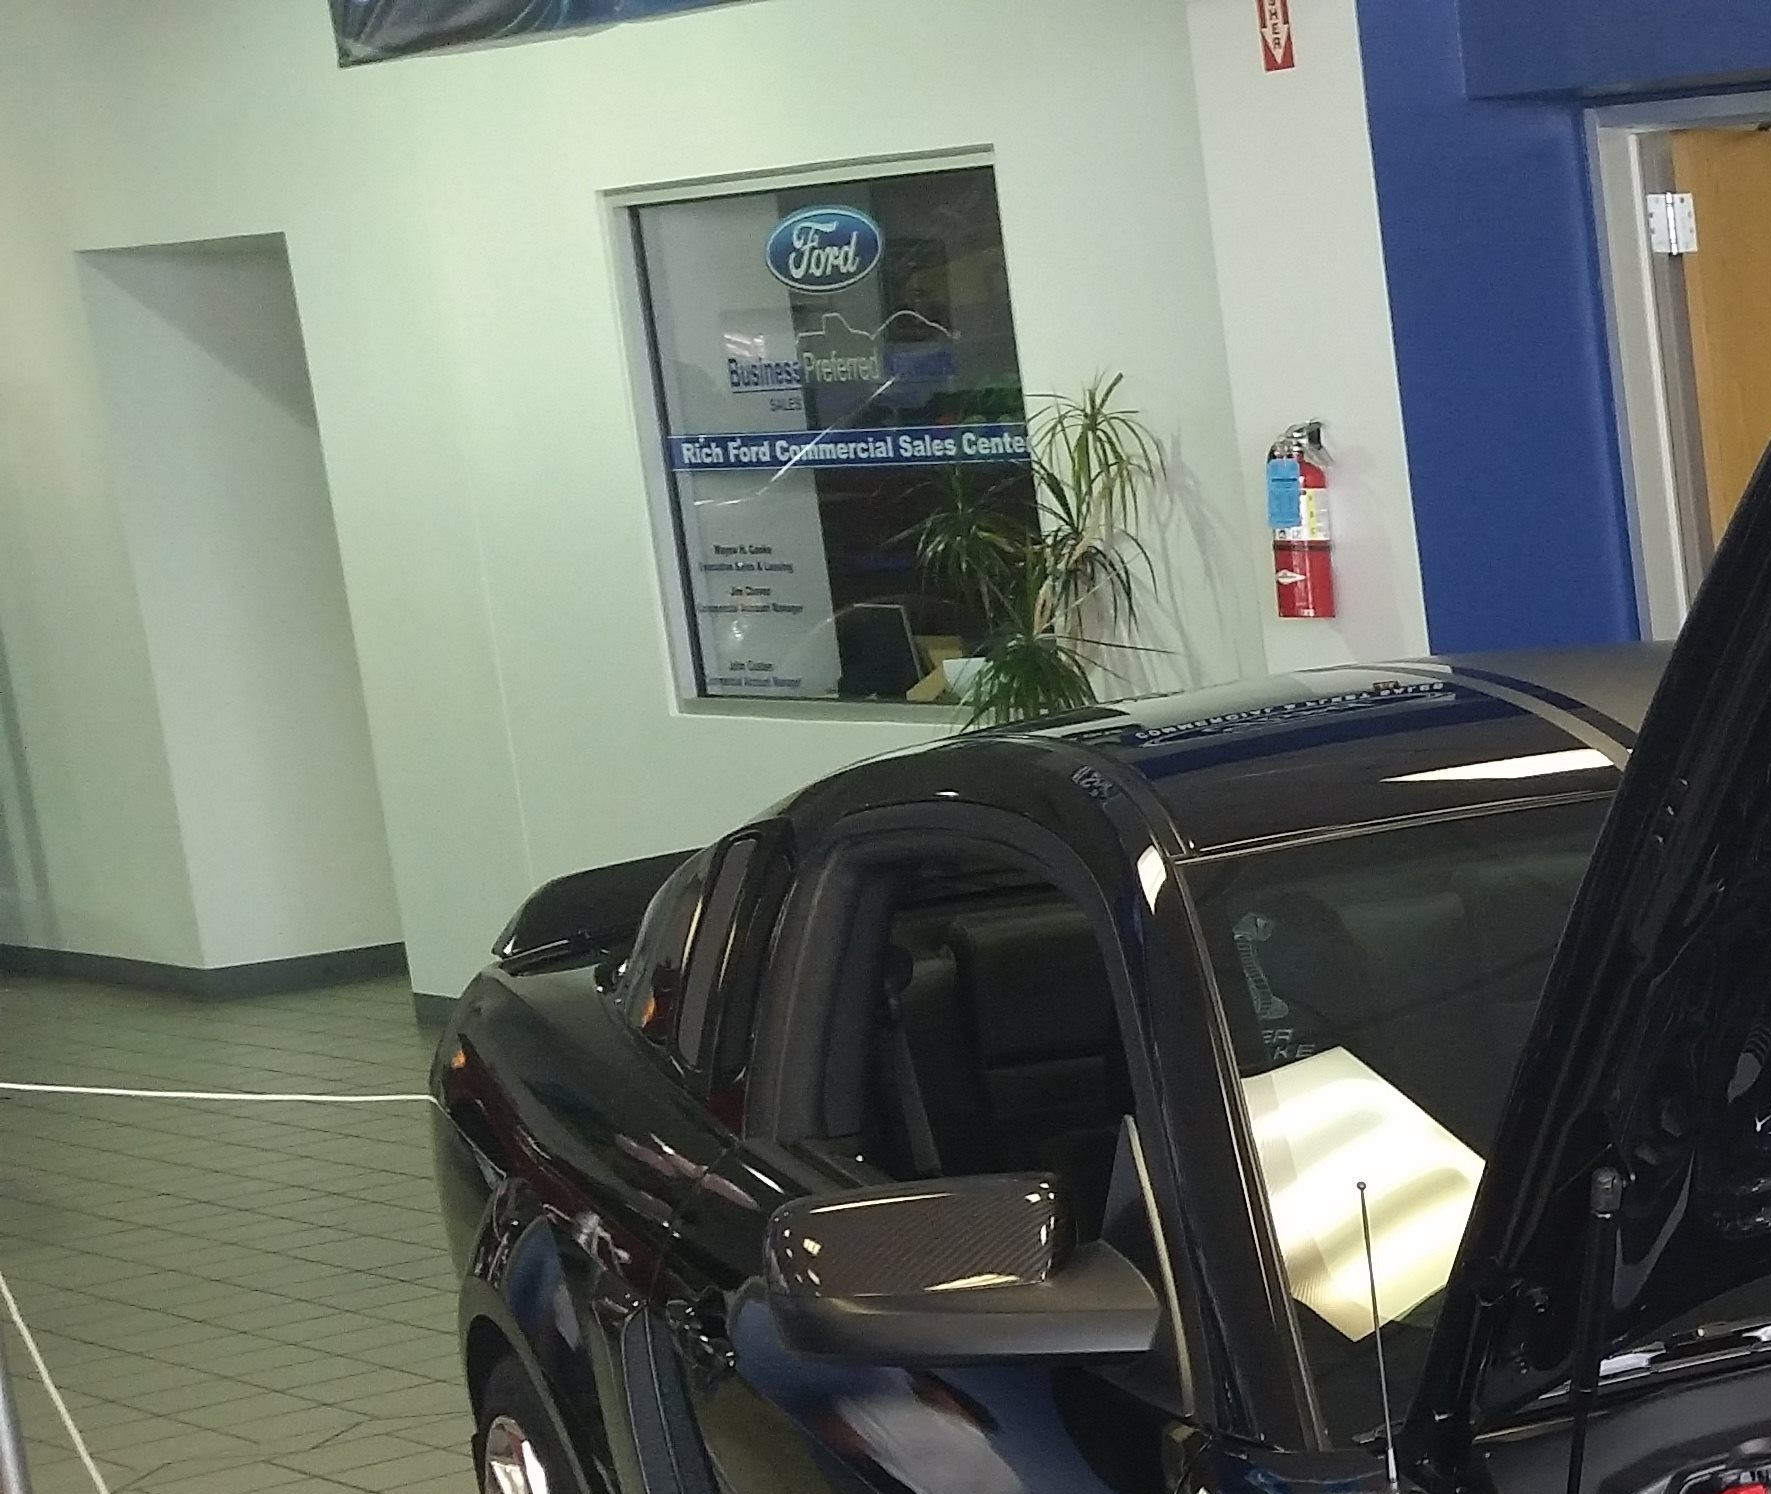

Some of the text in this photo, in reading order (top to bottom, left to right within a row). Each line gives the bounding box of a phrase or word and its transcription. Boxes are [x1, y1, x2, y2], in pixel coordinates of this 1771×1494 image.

[682, 438, 724, 465] Rich
[728, 438, 770, 463] Ford
[775, 436, 895, 460] Commercial
[899, 434, 956, 458] Sales
